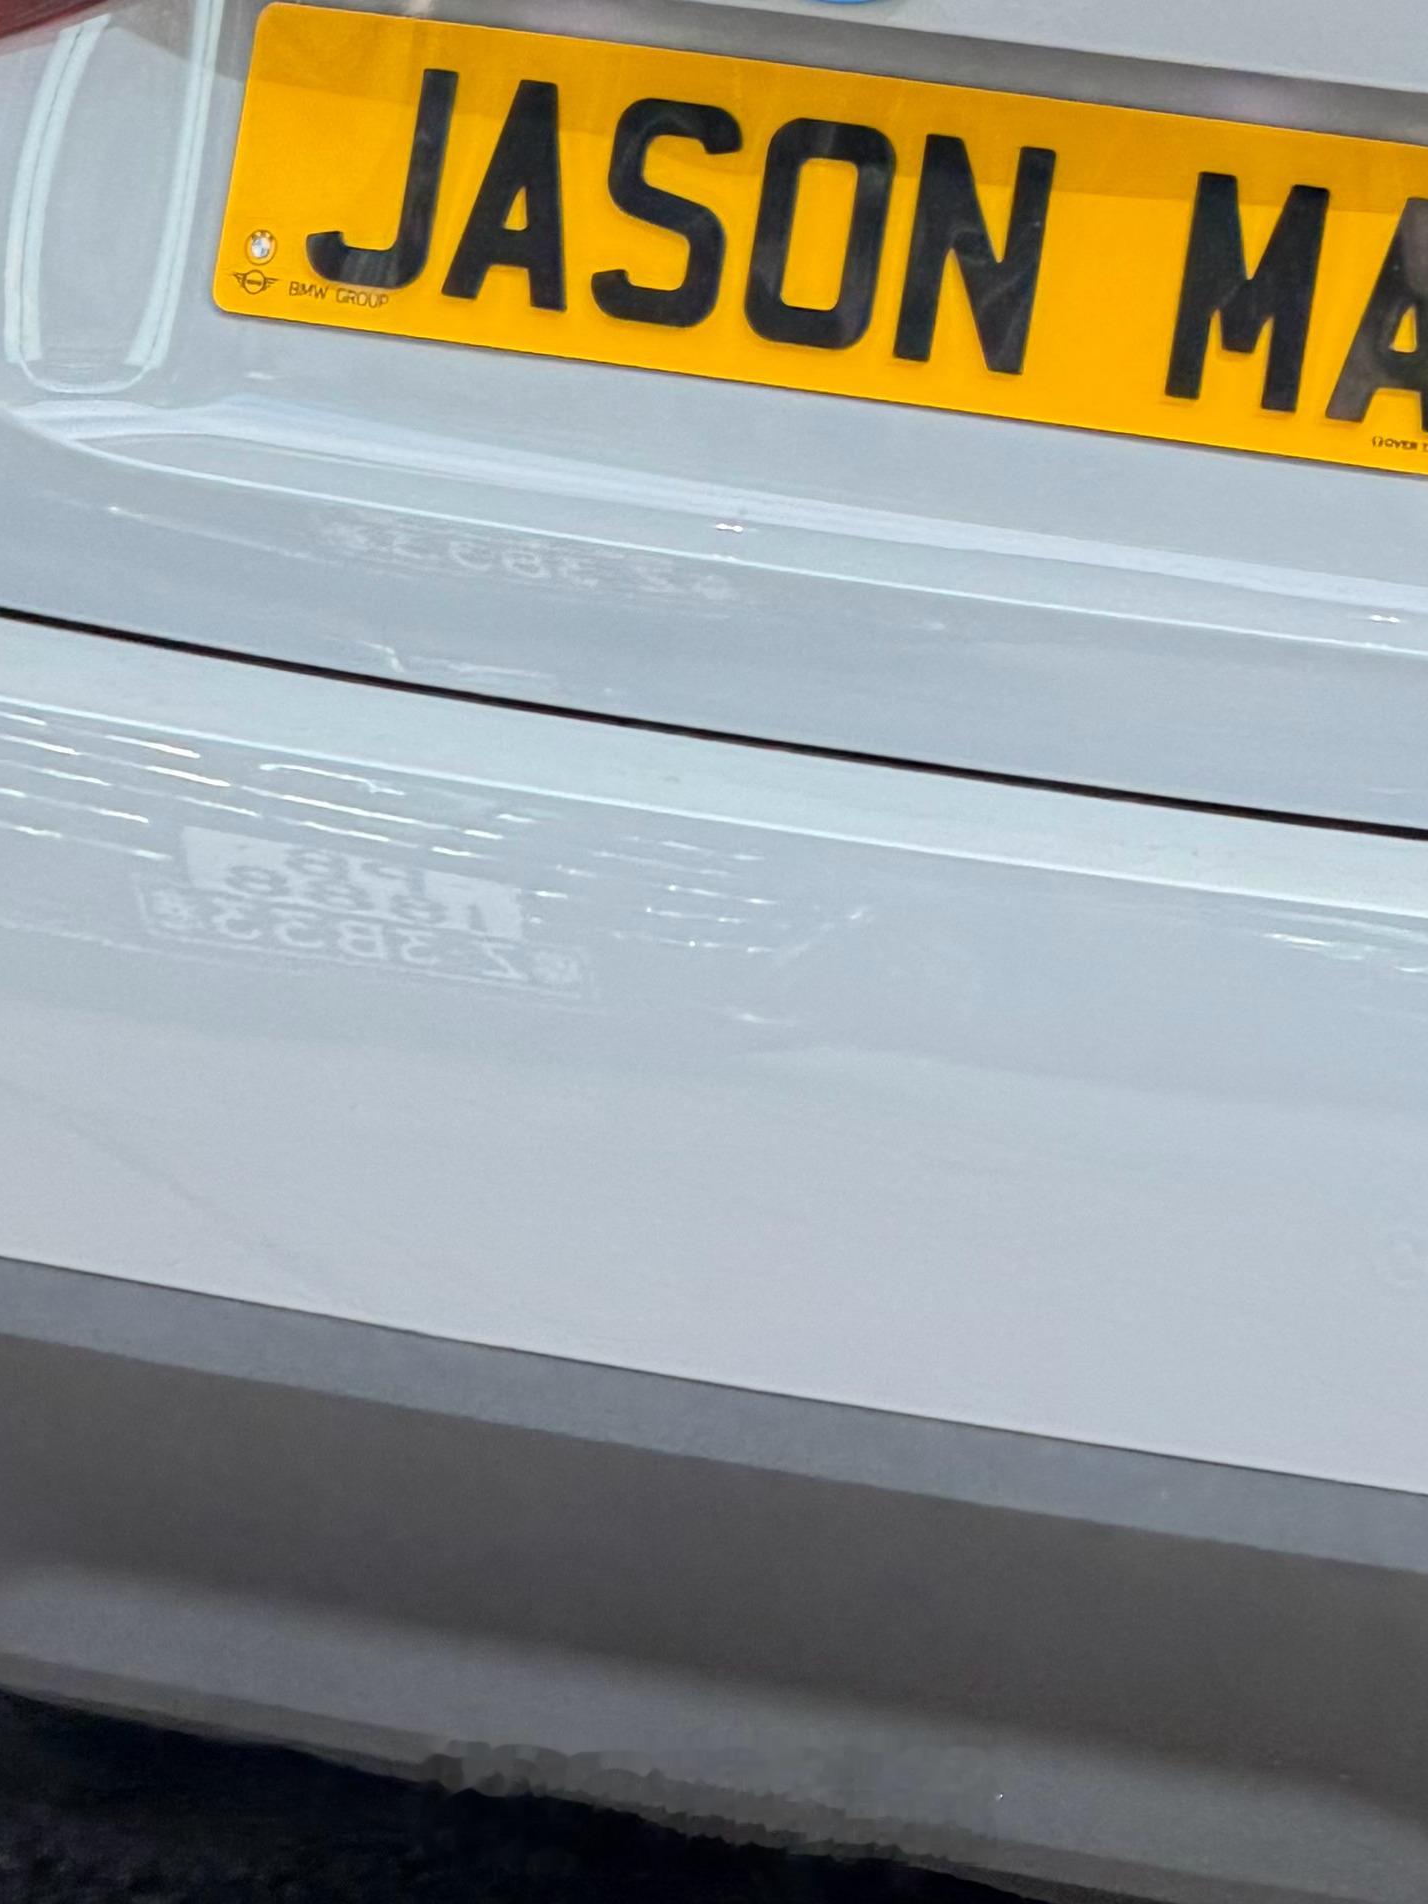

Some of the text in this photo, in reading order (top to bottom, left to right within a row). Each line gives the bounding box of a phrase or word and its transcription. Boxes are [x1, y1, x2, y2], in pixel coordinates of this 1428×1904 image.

[288, 280, 330, 300] BMW
[335, 287, 390, 309] GROUP
[305, 68, 1057, 375] JASON
